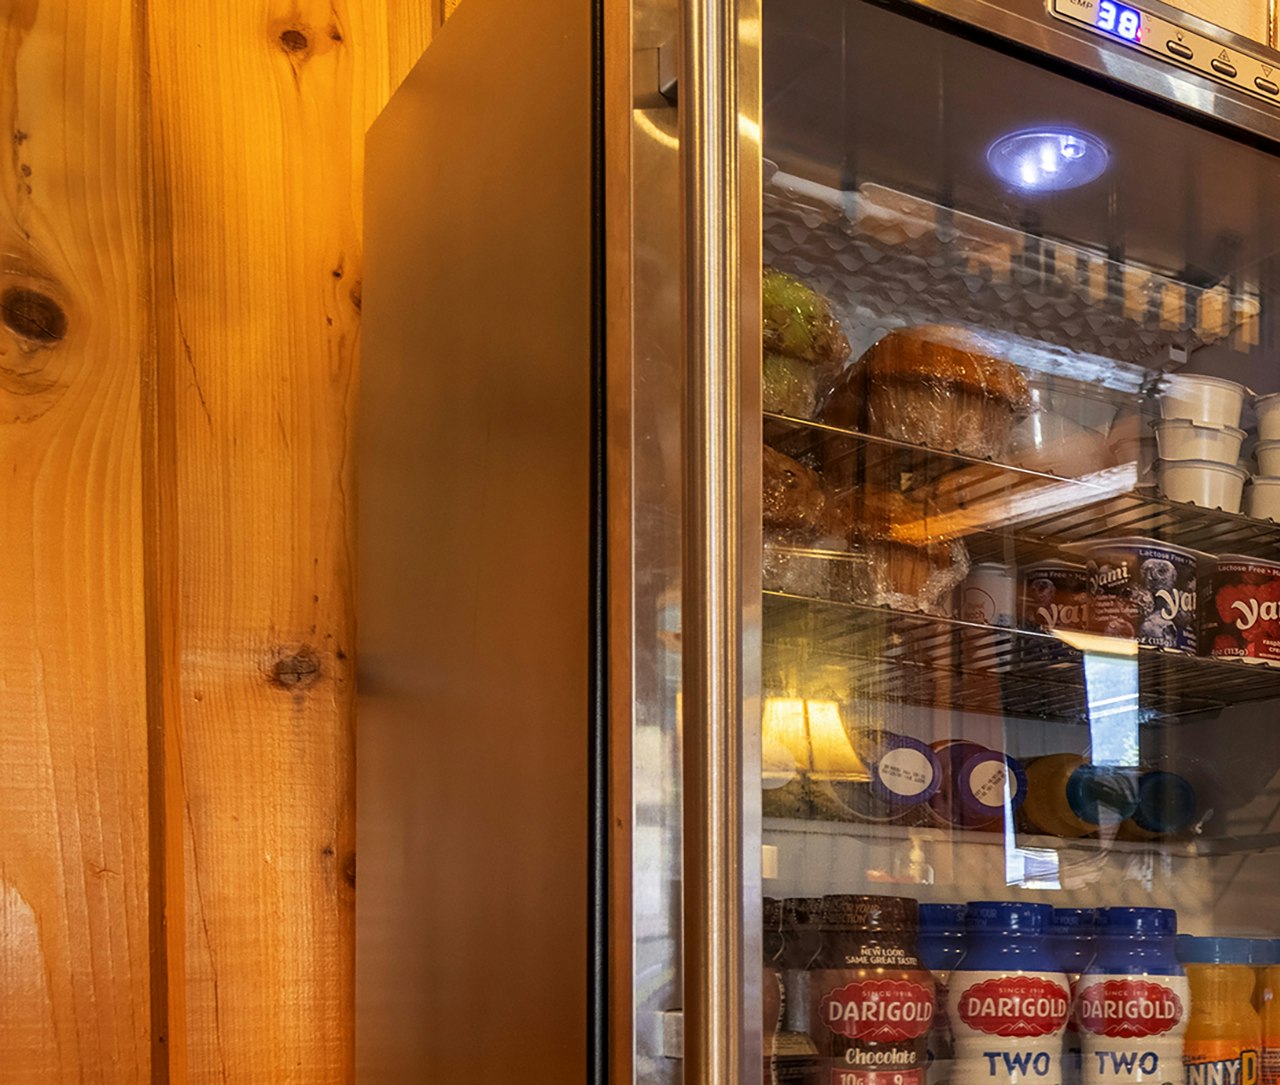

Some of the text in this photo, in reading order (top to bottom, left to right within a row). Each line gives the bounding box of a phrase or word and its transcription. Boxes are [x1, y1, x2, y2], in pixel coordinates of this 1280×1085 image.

[1097, 2, 1141, 40] 38
[1248, 566, 1266, 575] Free
[1155, 588, 1197, 620] ya
[870, 956, 895, 965] GREAT
[829, 1001, 933, 1022] DARIGOLD
[967, 997, 1067, 1018] DARIGOLD
[1082, 1000, 1176, 1019] DARIGOLD
[845, 1048, 917, 1065] Chocolate
[982, 1051, 1051, 1077] TWO
[1095, 1051, 1159, 1075] TWO
